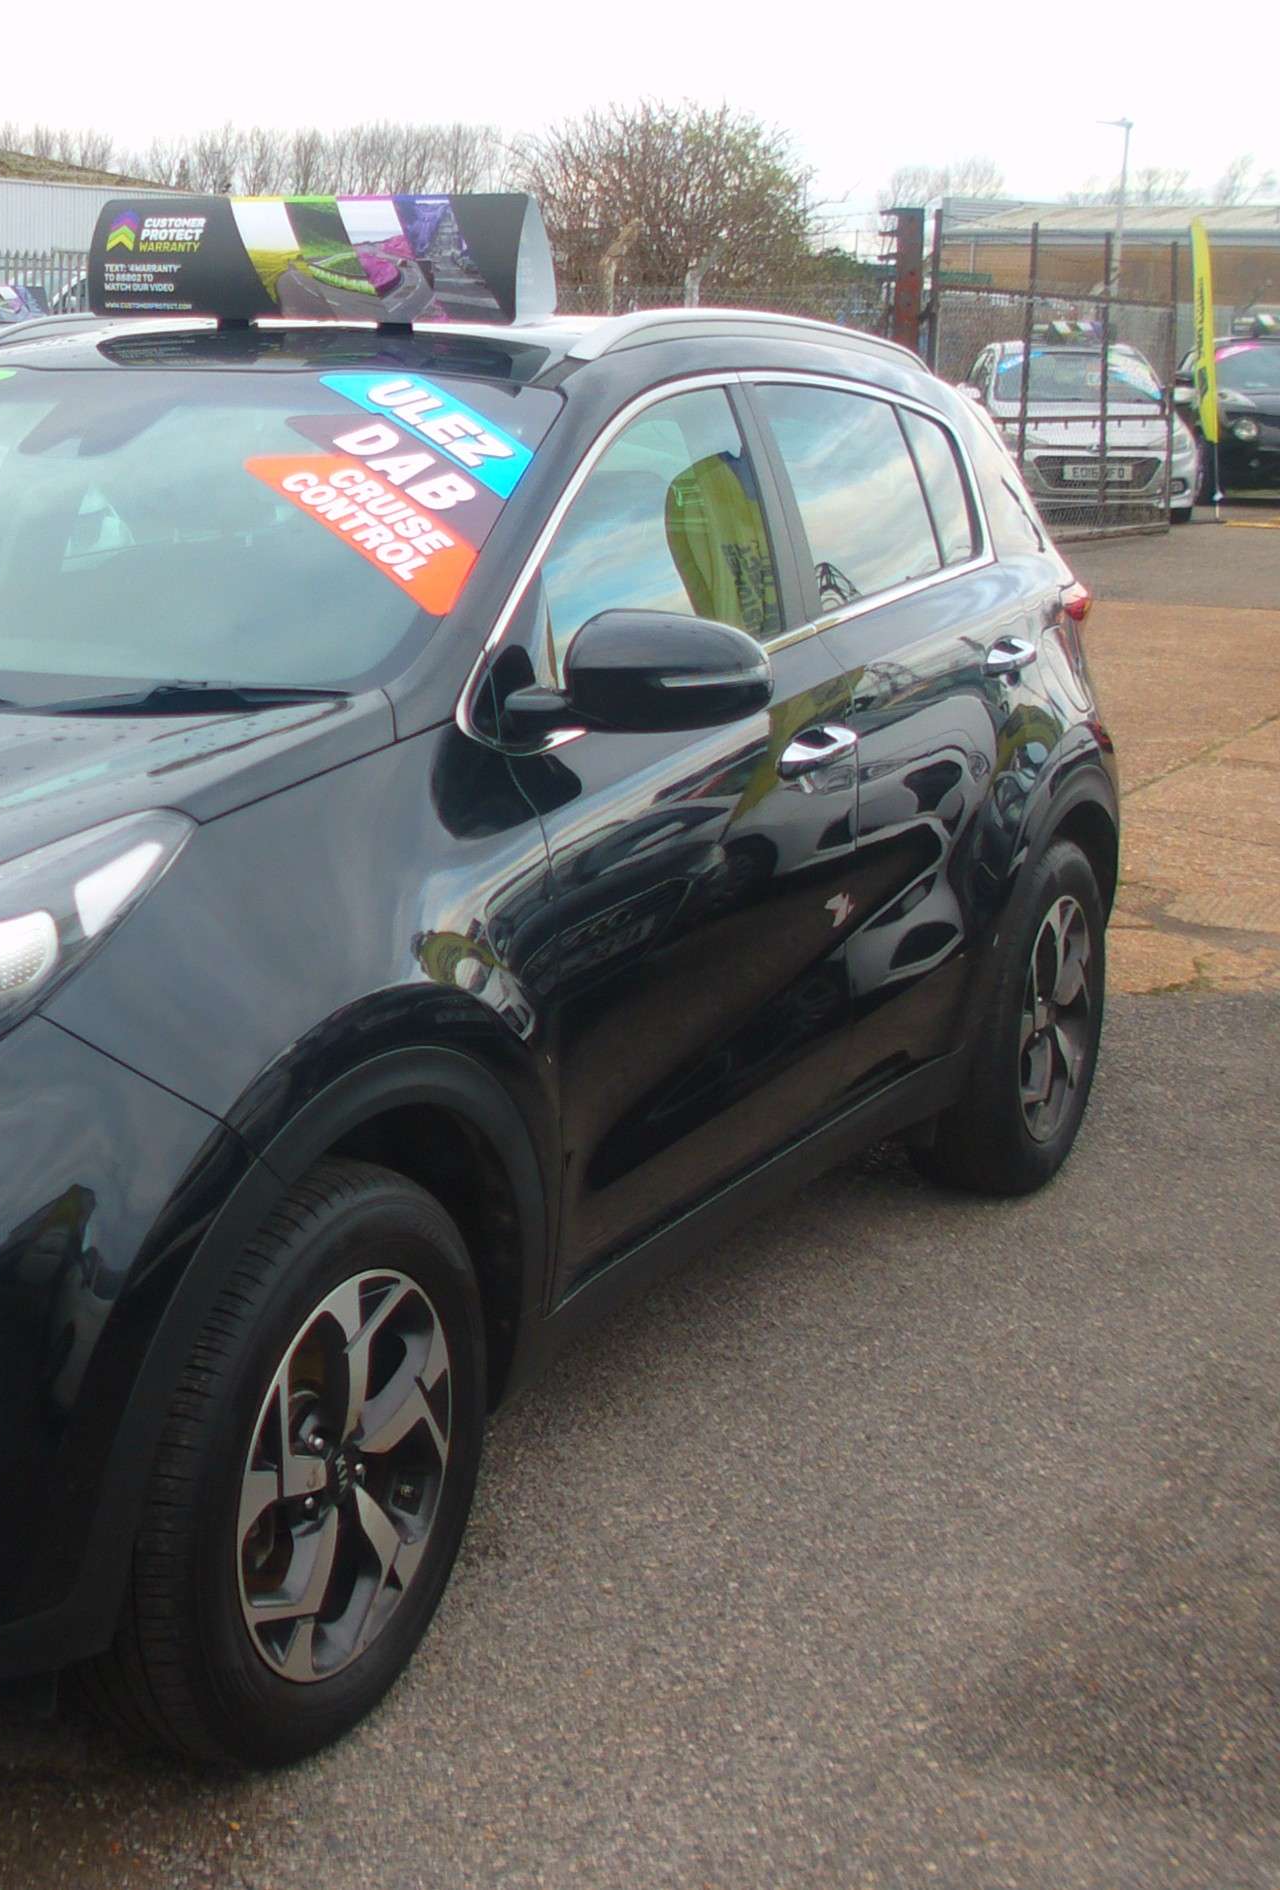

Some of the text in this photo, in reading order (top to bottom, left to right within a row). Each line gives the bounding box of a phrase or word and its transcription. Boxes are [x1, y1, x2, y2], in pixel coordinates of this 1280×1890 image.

[144, 217, 206, 229] CUSTOMER
[140, 228, 204, 241] PROTECT
[139, 241, 201, 253] WARRANTY
[104, 273, 115, 282] TO
[143, 273, 154, 283] TO
[104, 282, 175, 293] WATCH OUR VIDEO
[367, 379, 517, 468] ULEZ
[332, 423, 477, 511] DAB
[328, 467, 456, 557] CRUISE
[281, 471, 429, 583] CONTROL
